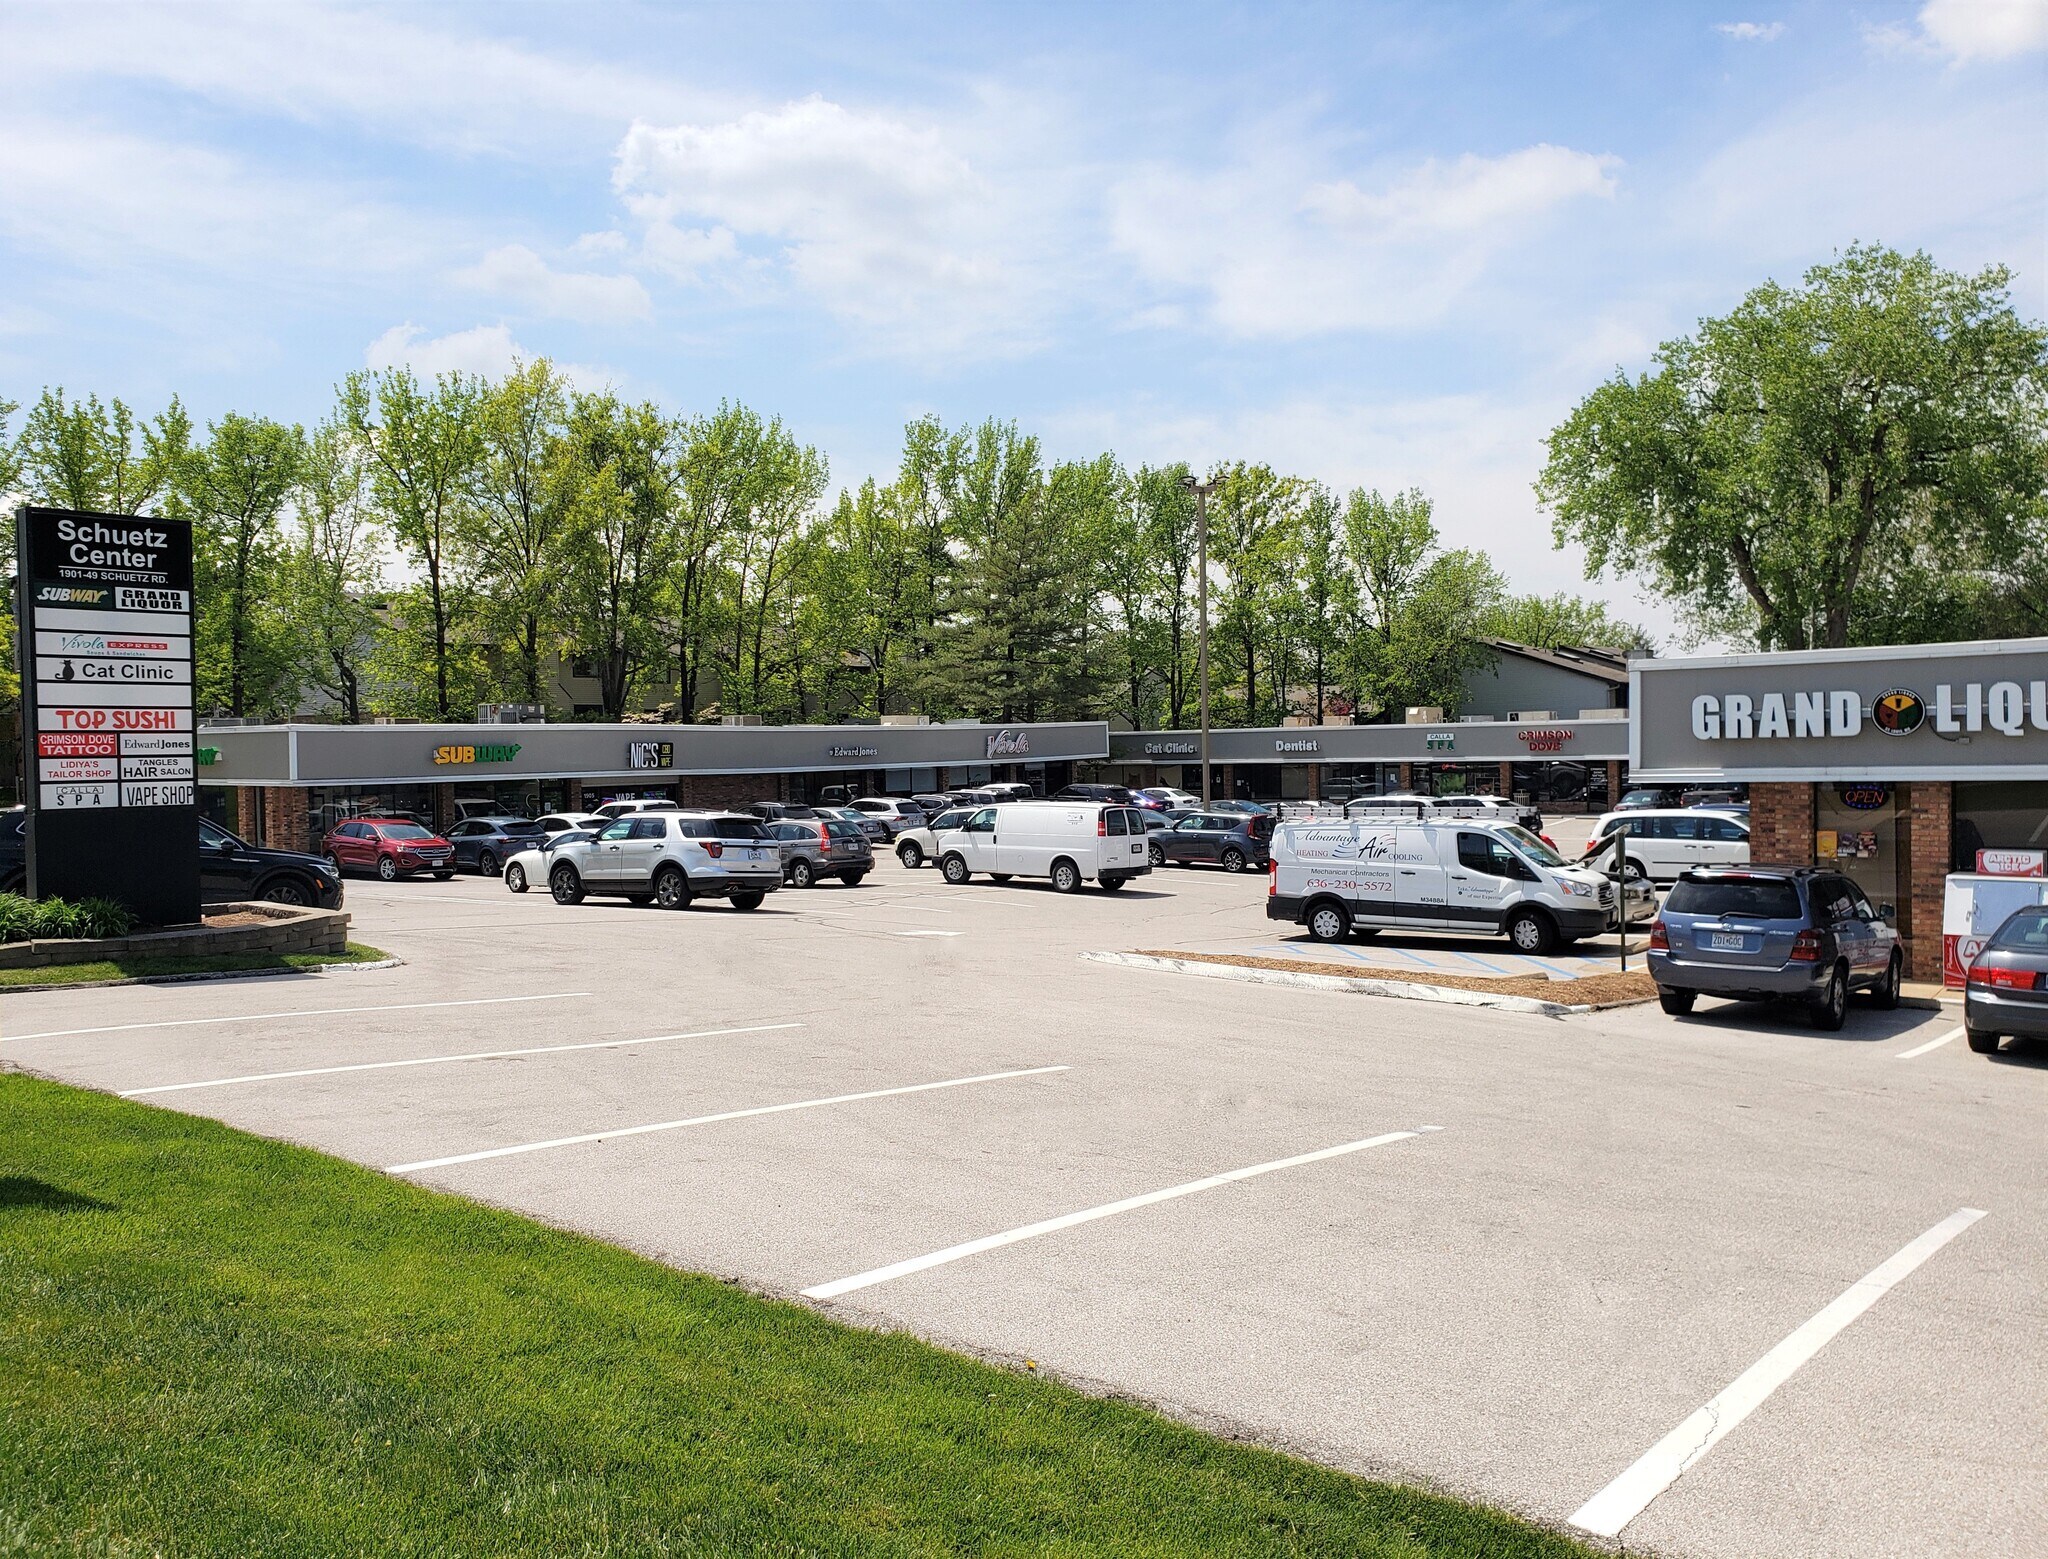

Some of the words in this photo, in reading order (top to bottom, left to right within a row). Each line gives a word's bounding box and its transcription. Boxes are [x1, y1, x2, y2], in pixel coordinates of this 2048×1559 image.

[57, 519, 168, 548] Schuetz
[69, 543, 157, 568] Center
[59, 569, 98, 580] 1901-49
[100, 572, 149, 583] SCHUETZ
[151, 575, 169, 584] RD.
[37, 587, 109, 603] SUBWAY
[122, 589, 181, 601] GRAND
[121, 599, 183, 610] LIQUOR
[61, 634, 105, 651] Vivola
[109, 642, 167, 650] EXPRESS
[82, 663, 115, 678] Cat
[121, 664, 174, 679] Clinic
[55, 710, 106, 729] TOP
[112, 711, 176, 729] SUSHI
[1691, 690, 1862, 741] GRAND
[40, 735, 86, 745] CRIMSON
[88, 734, 115, 745] DOVE
[1518, 730, 1574, 741] CRIMSON
[43, 744, 112, 755] TATTOO
[1144, 743, 1163, 754] Cat
[1165, 742, 1195, 753] Clinic
[1275, 740, 1318, 752] Dentist
[1427, 740, 1455, 751] SPA
[1529, 742, 1562, 751] DOVE
[433, 744, 521, 765] SUBWAY
[60, 761, 99, 769] LIDIYA'S
[47, 770, 83, 778] TAILOR
[85, 770, 111, 778] SHOP
[123, 767, 158, 778] HAIR
[160, 768, 191, 776] SALON
[127, 787, 158, 806] VAPE
[162, 786, 194, 805] SHOP
[615, 793, 636, 802] VAPE
[1845, 790, 1884, 803] OPEN
[1296, 830, 1360, 846] Advantage
[1358, 837, 1389, 859] Air
[1296, 849, 1329, 857] HEATING
[1388, 853, 1423, 861] COOLING
[1989, 854, 2031, 864] ARCTIC
[1311, 868, 1347, 876] Mechanical
[1349, 869, 1390, 877] Contractors
[1999, 863, 2022, 872] ICE
[1307, 878, 1393, 892] 636-230-5572
